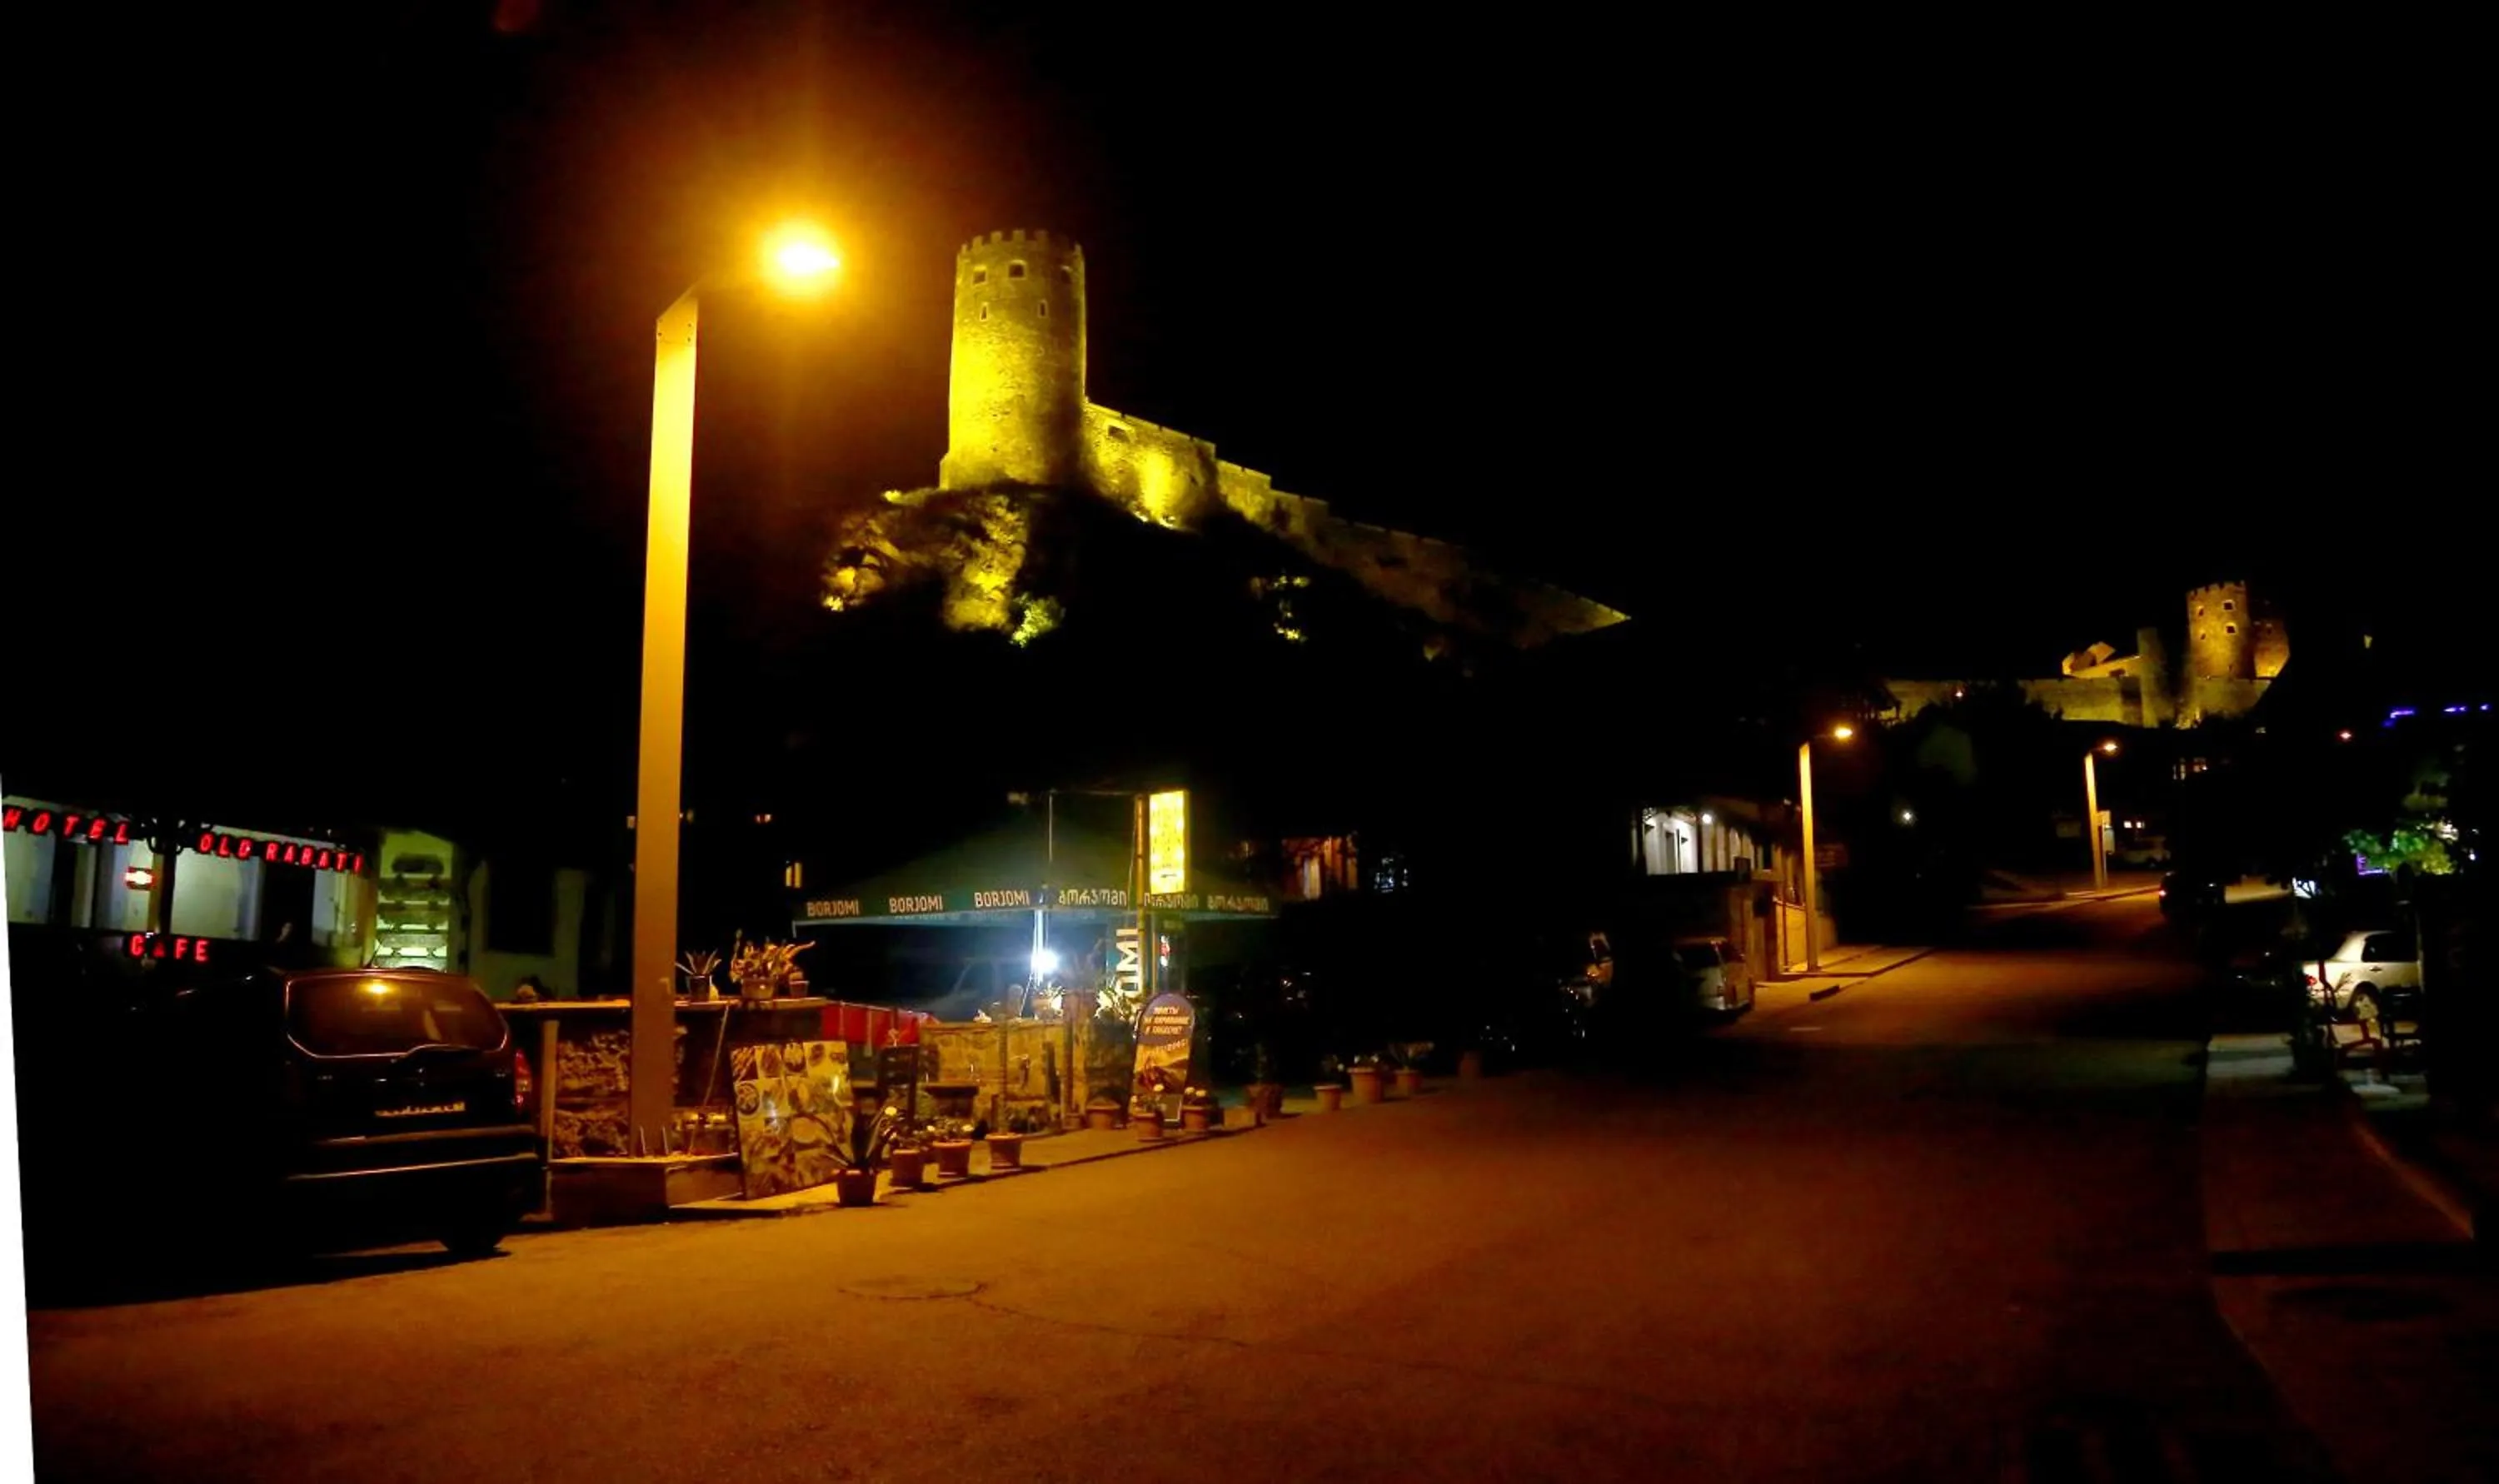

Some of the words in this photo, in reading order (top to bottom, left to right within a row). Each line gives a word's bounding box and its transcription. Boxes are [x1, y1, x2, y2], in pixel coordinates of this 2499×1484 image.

[2, 808, 130, 843] HOTEL
[199, 833, 252, 859] OLD
[265, 841, 363, 874] RABATI
[806, 899, 860, 917] BORJOMI
[889, 895, 943, 914] BORJOMI
[974, 889, 1030, 908] BORJOMI
[128, 932, 211, 964] CAFE
